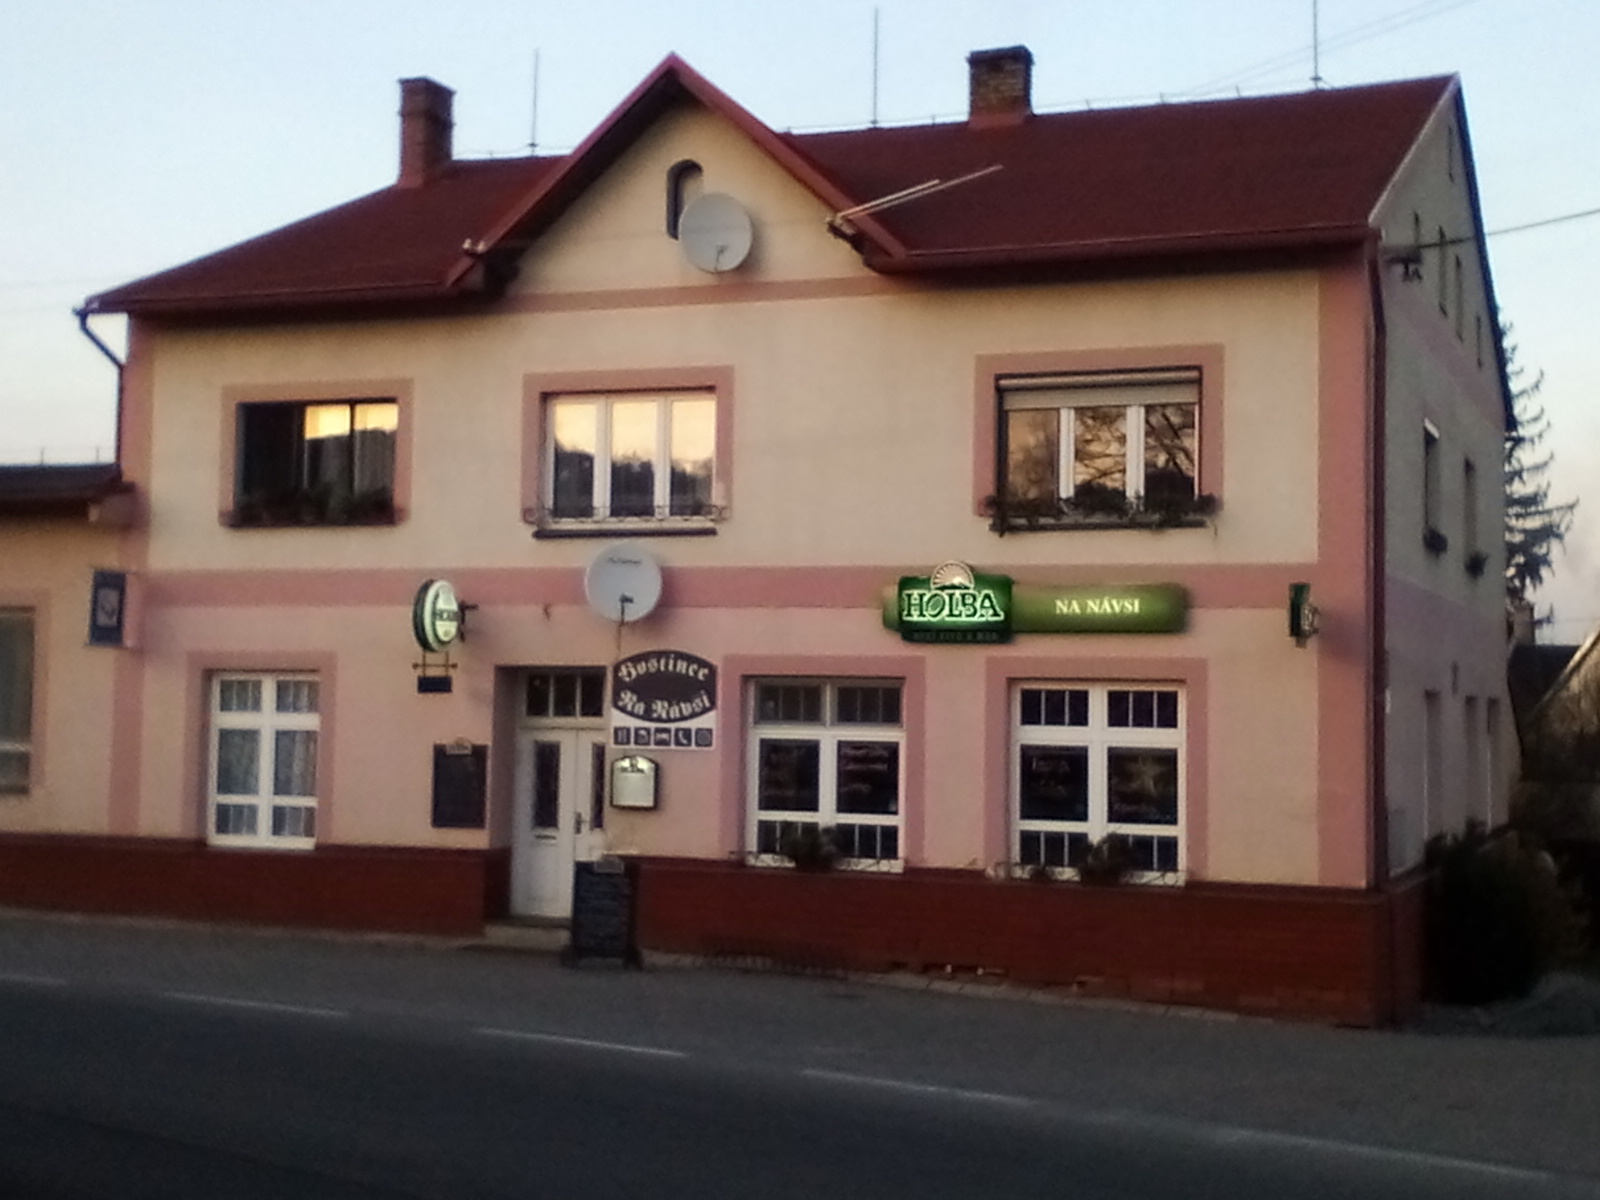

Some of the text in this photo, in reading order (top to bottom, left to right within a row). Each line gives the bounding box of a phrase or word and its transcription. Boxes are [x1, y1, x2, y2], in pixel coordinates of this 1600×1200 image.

[902, 589, 1005, 621] HOLBA
[1055, 596, 1140, 615] NA NÁVSI
[618, 653, 709, 682] Hostinec
[617, 689, 646, 716] Na
